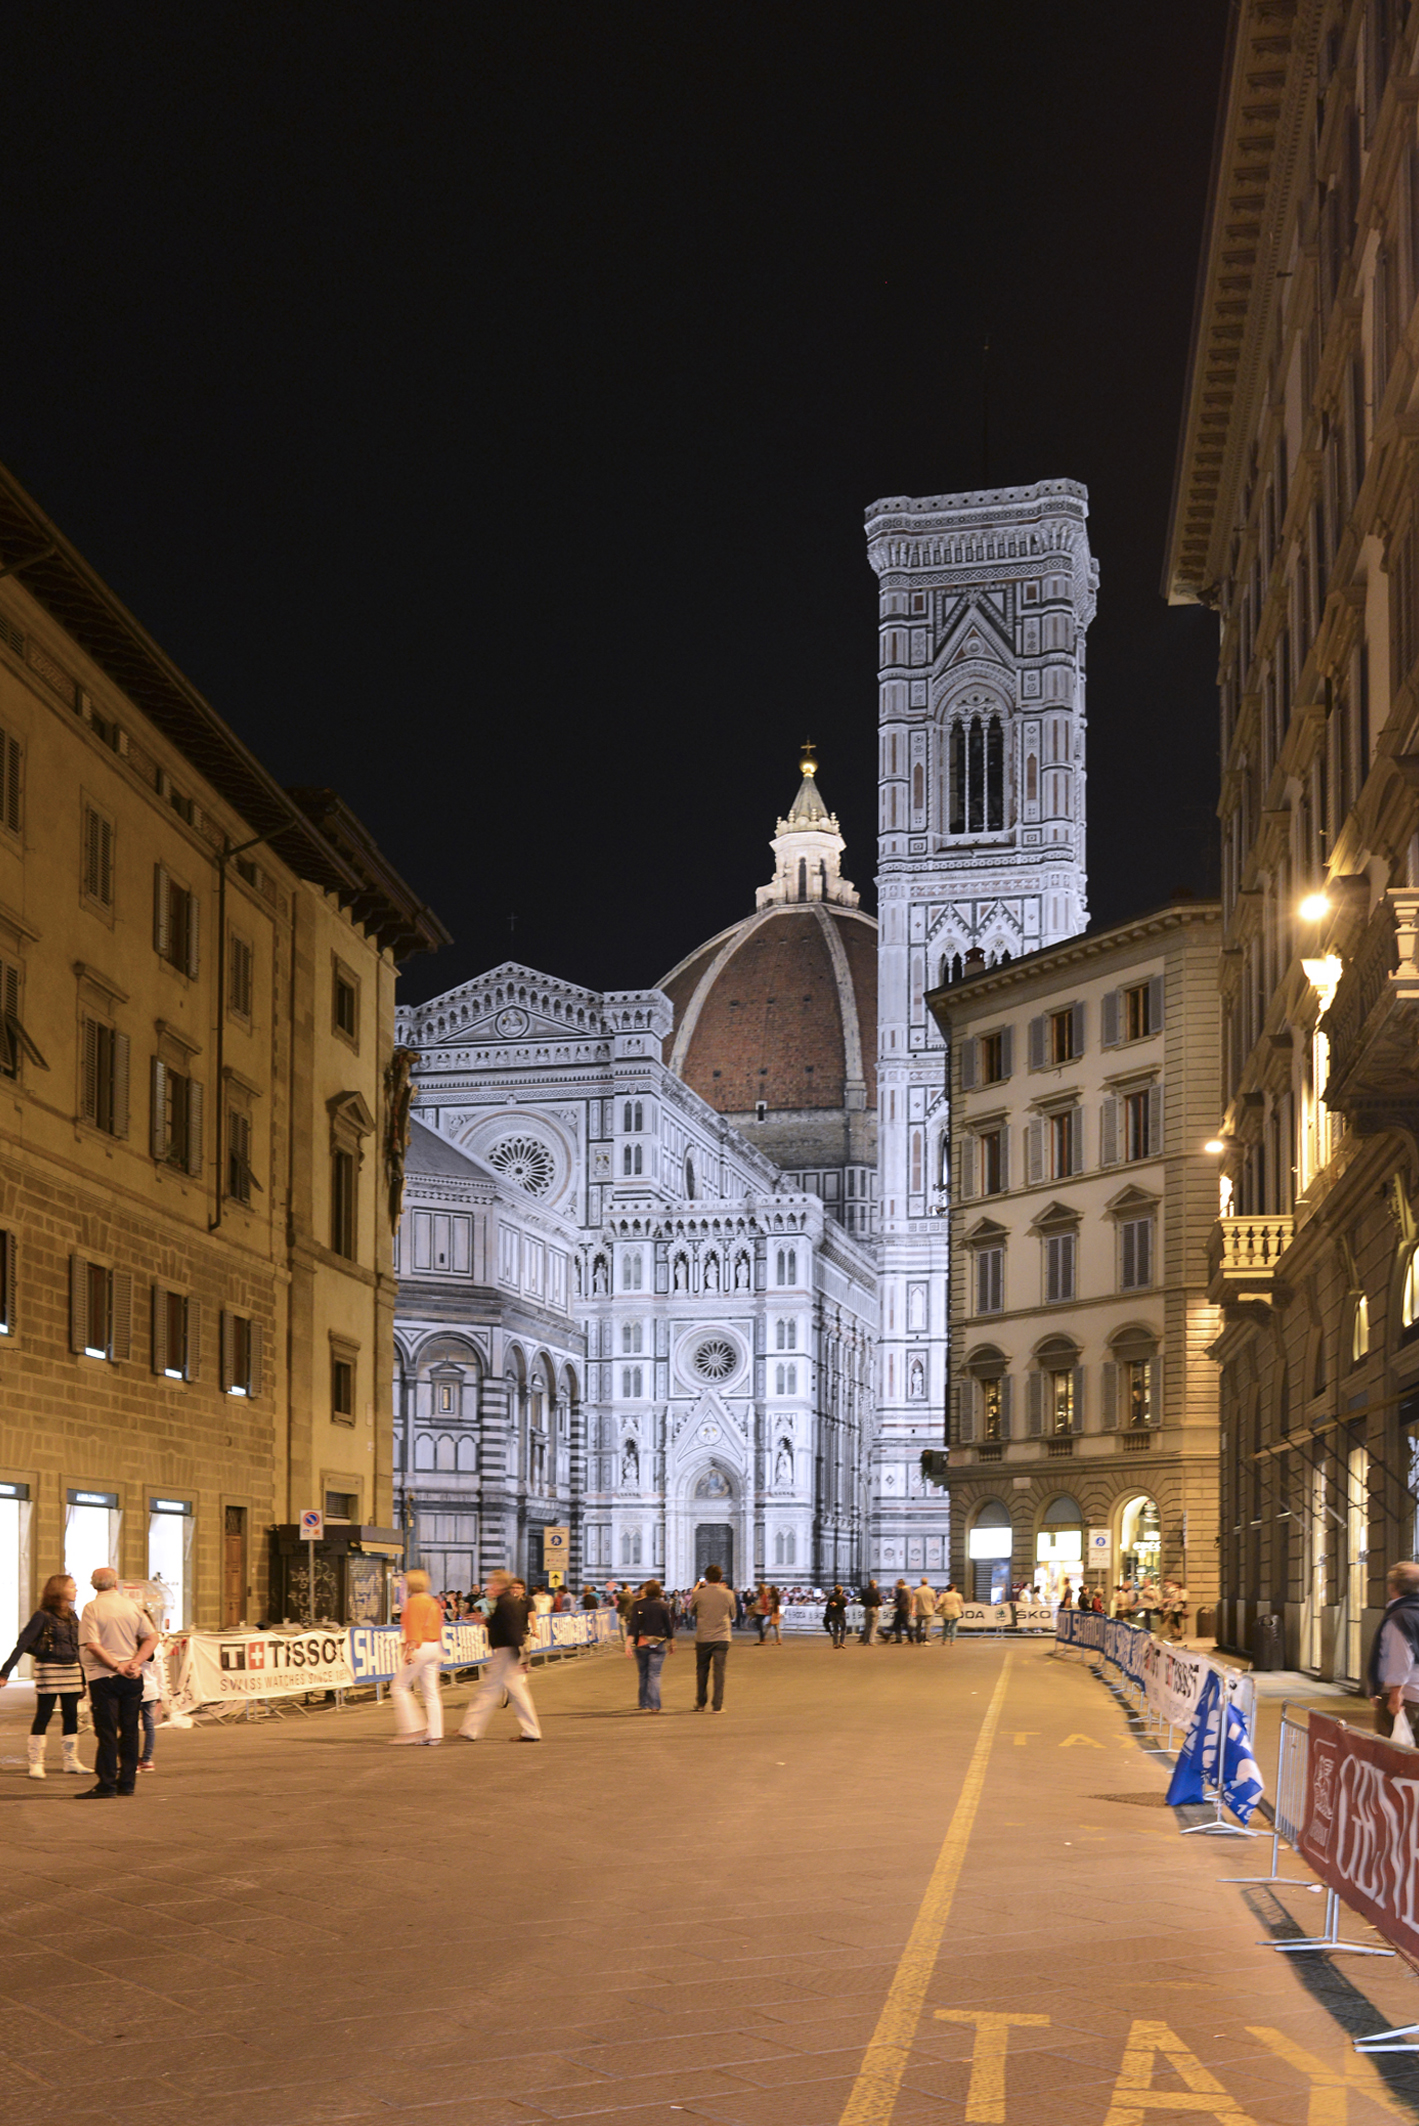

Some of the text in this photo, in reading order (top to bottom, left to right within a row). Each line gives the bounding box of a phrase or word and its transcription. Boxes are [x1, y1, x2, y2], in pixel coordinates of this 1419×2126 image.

[268, 1638, 345, 1668] TISSOT
[219, 1677, 262, 1692] SWISS
[265, 1673, 304, 1688] WATCHES
